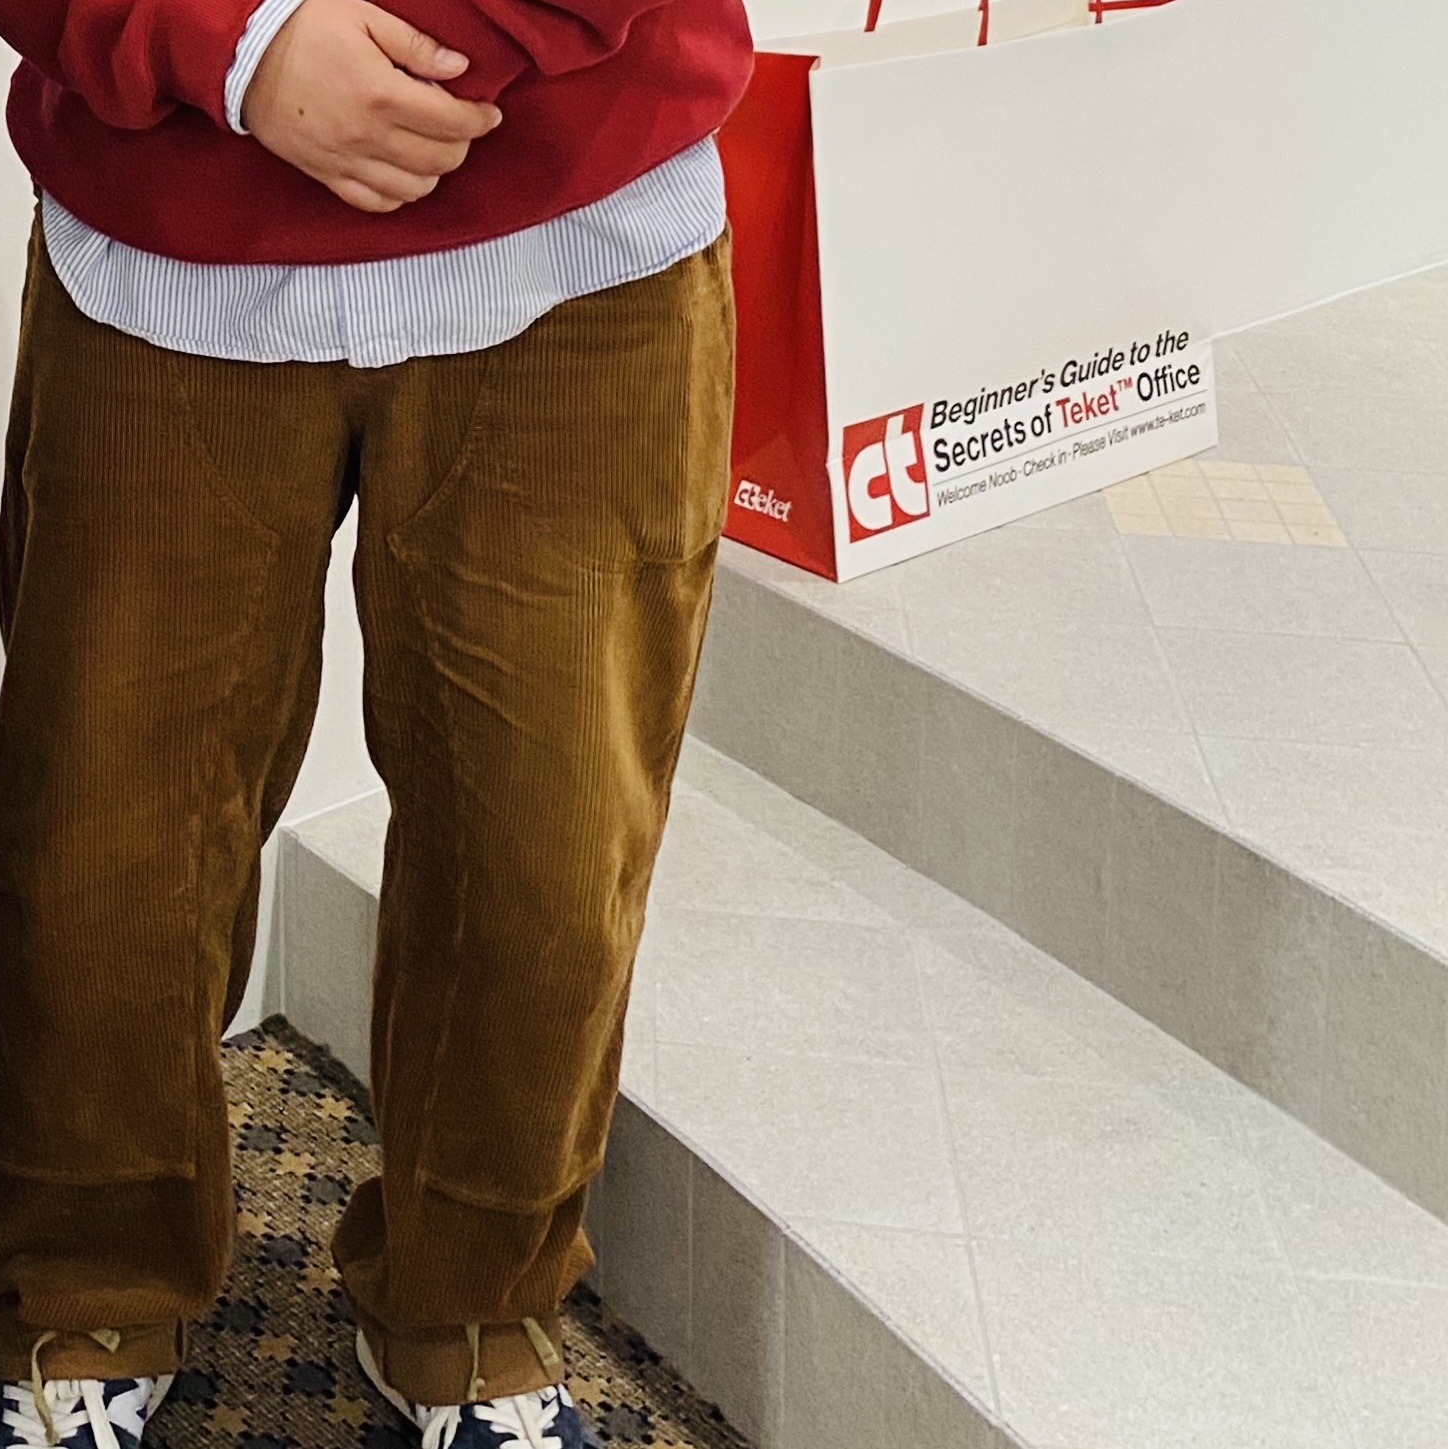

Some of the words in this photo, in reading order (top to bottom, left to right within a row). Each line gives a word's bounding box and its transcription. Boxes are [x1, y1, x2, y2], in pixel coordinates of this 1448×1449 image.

[931, 369, 1055, 429] Beginner's
[1060, 348, 1125, 388] Guide
[1129, 342, 1150, 366] to
[1155, 329, 1190, 357] the
[934, 418, 1027, 472] Secrets
[1031, 403, 1052, 437] of
[1137, 363, 1201, 402] Office
[937, 478, 987, 507] Welcome
[989, 466, 1017, 488] Noob
[1023, 453, 1056, 477] Check
[1057, 450, 1067, 465] in
[1072, 436, 1106, 459] Please
[1107, 426, 1129, 447] Visit
